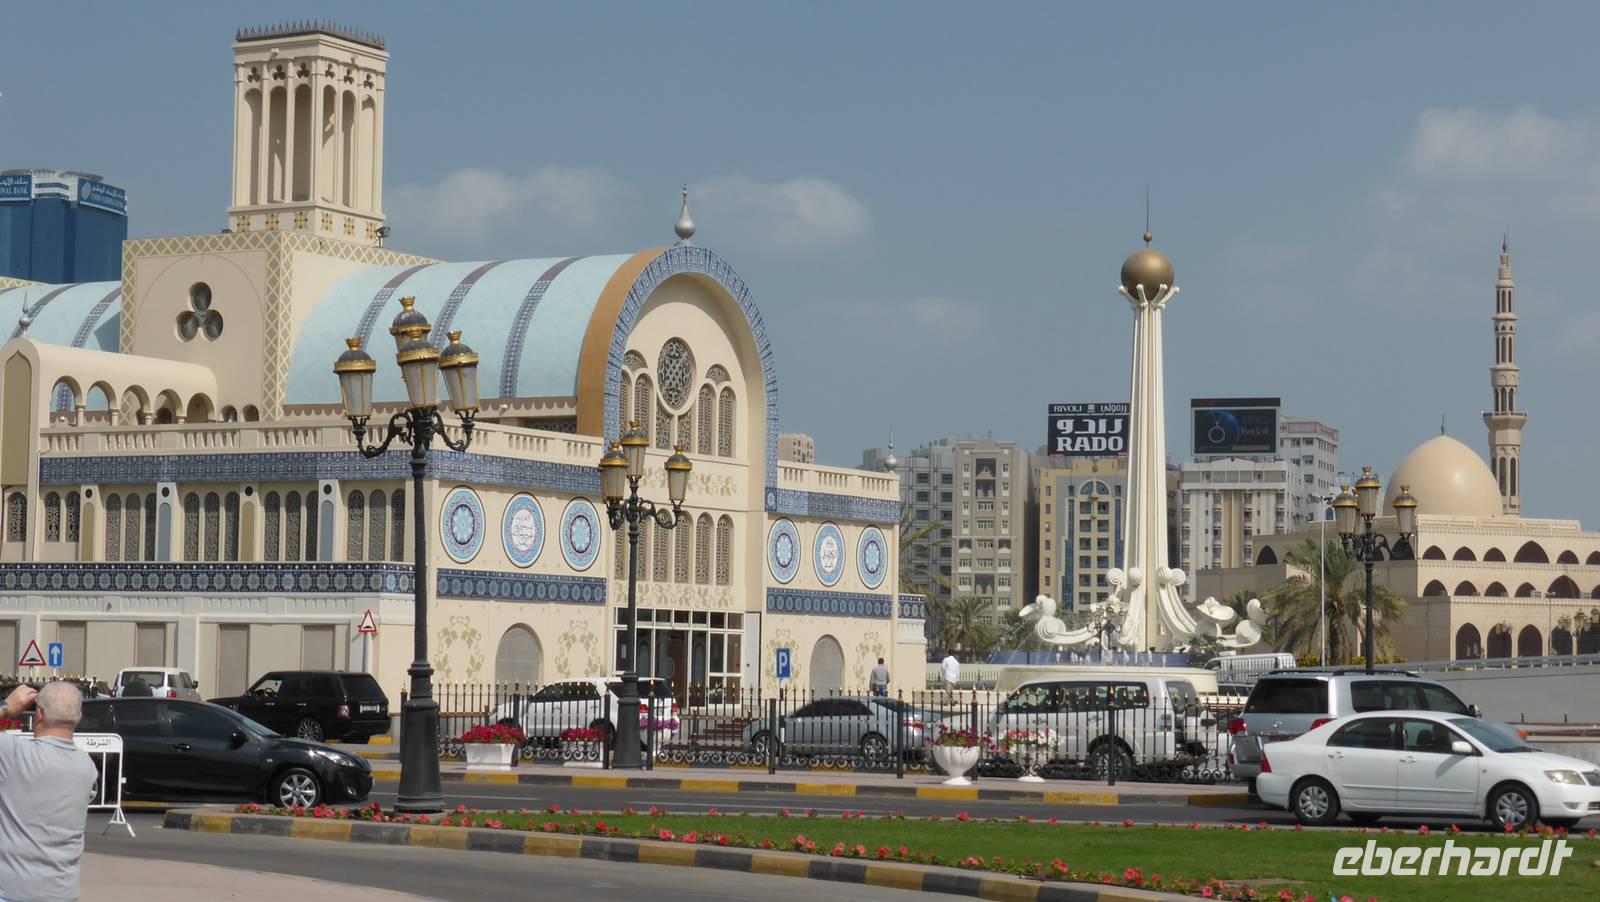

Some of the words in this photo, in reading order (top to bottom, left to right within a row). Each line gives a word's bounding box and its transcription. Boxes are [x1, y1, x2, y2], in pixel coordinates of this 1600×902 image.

[1056, 419, 1123, 434] رادو
[1056, 436, 1123, 451] RADO
[779, 651, 788, 675] P
